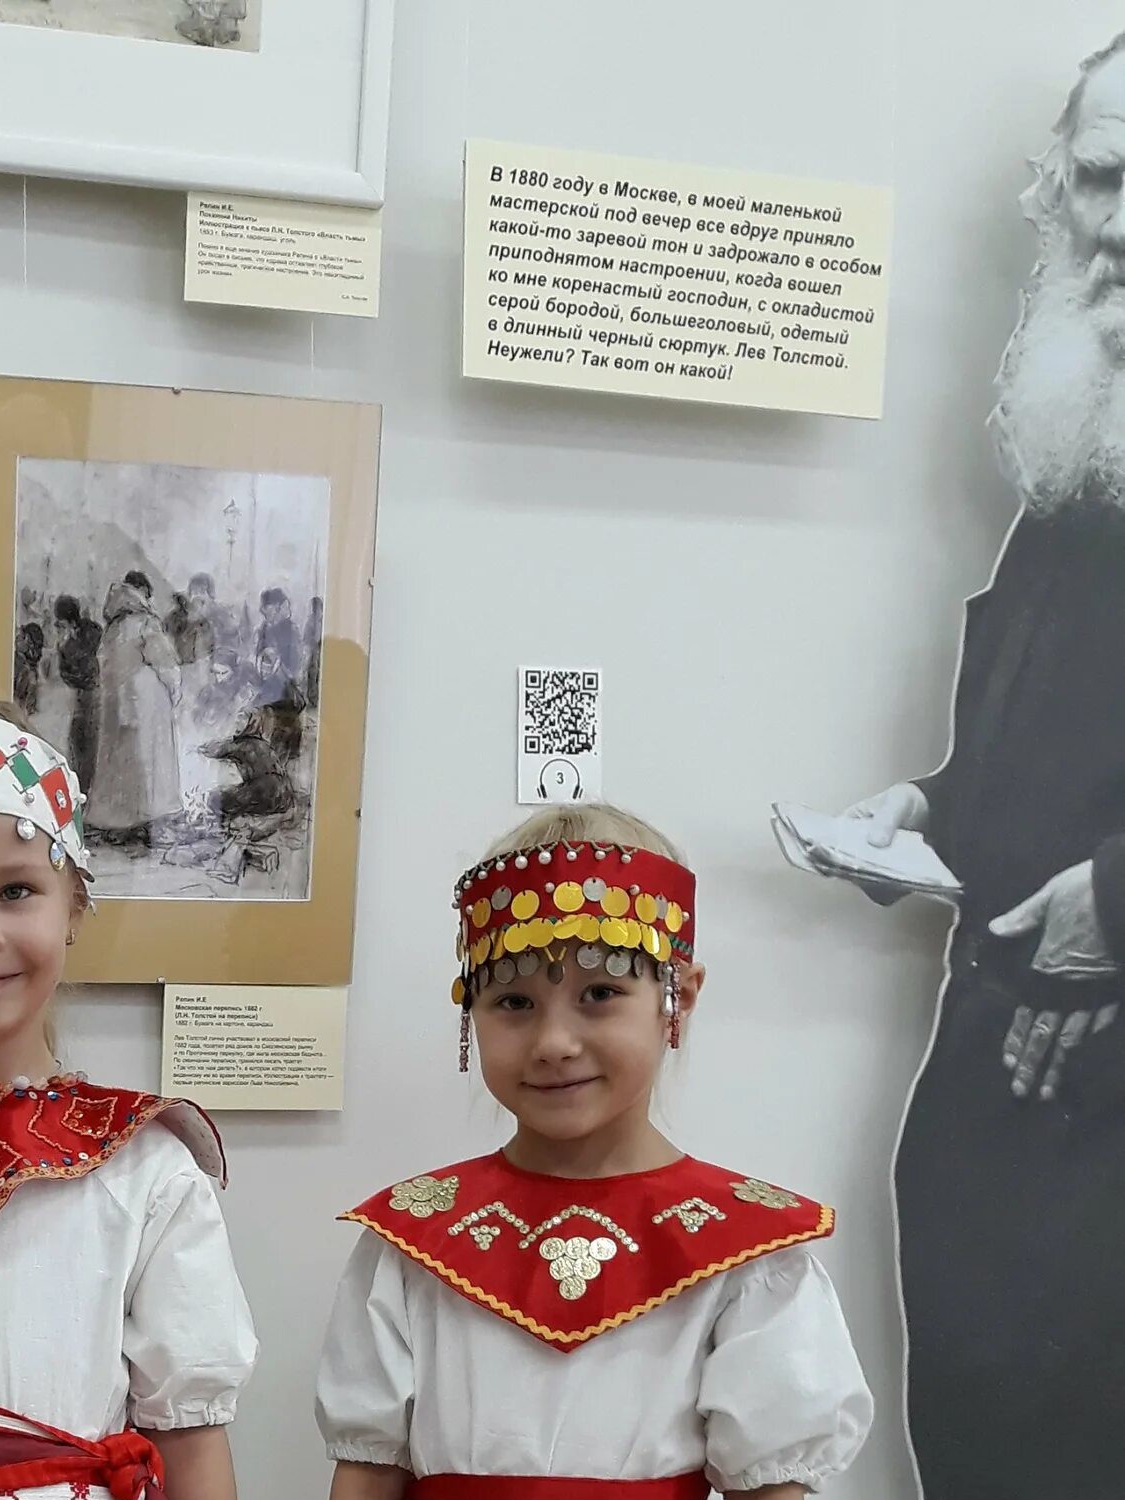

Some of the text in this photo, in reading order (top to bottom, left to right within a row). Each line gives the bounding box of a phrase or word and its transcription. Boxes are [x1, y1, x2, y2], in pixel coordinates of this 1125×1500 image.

[490, 165, 841, 222] В 1880 году в Москве, в моей маленькой
[286, 227, 315, 237] Толстого
[489, 194, 854, 248] мастерской под вечер все вдруг приняло
[488, 219, 881, 276] какой-то заревой тон и задрожало в особом
[488, 244, 841, 296] приподнятом настроении, когда вошел
[488, 268, 874, 323] ко мне коренастый господин, с окладистой
[488, 294, 849, 344] серой бородой, большеголовый, одетый
[487, 315, 849, 368] в длинный черный сюртук. Лев Толстой.
[487, 339, 733, 380] Неужели? Так вот он какой!
[556, 772, 565, 785] 3
[227, 1012, 258, 1020] переписи)
